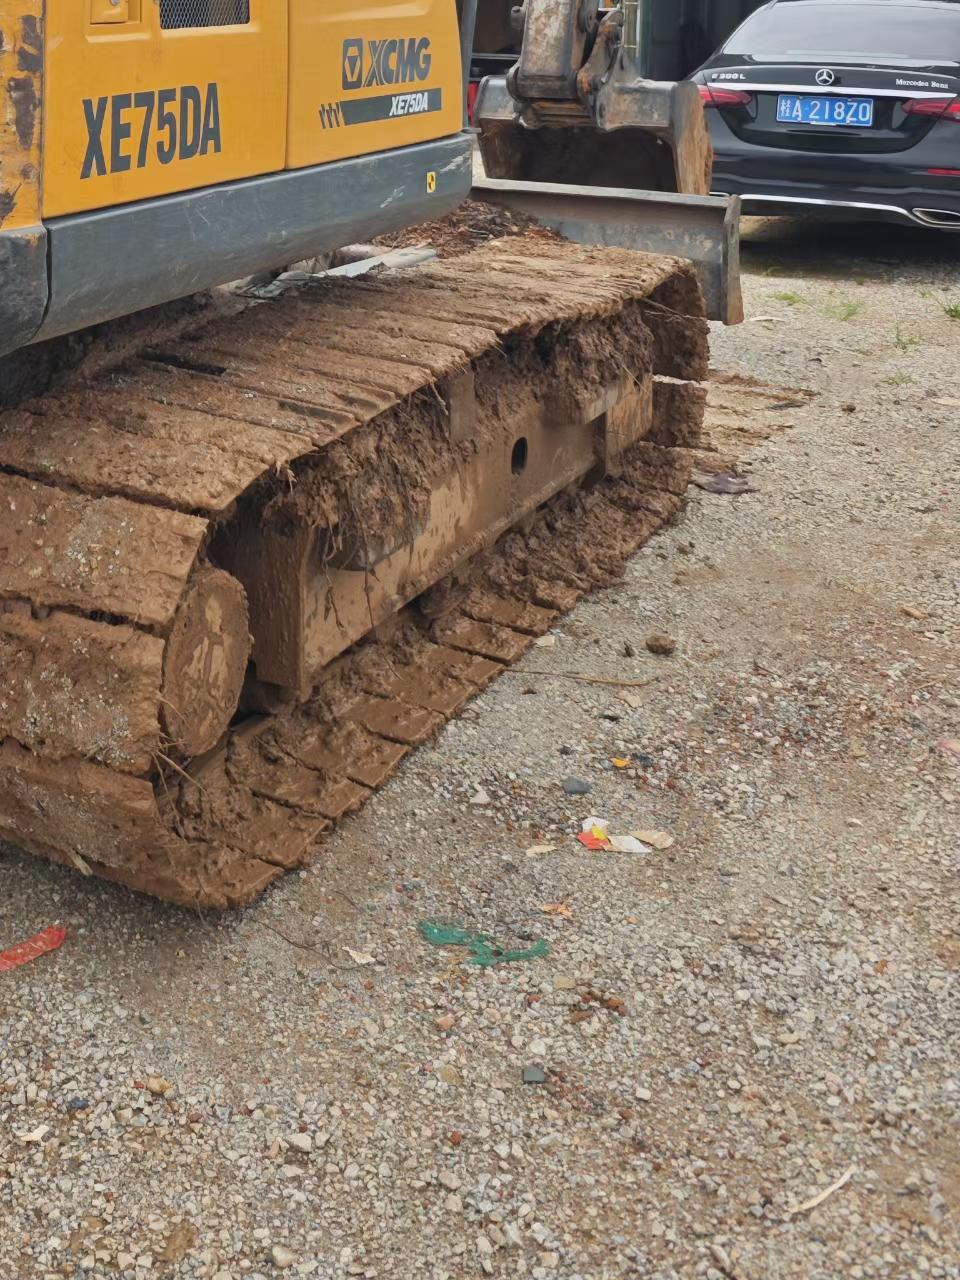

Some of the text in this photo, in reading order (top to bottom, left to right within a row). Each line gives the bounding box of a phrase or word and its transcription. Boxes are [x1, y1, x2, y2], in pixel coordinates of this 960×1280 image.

[362, 36, 432, 88] XCMG
[388, 86, 429, 117] XE75DA
[80, 82, 221, 180] XE75DA
